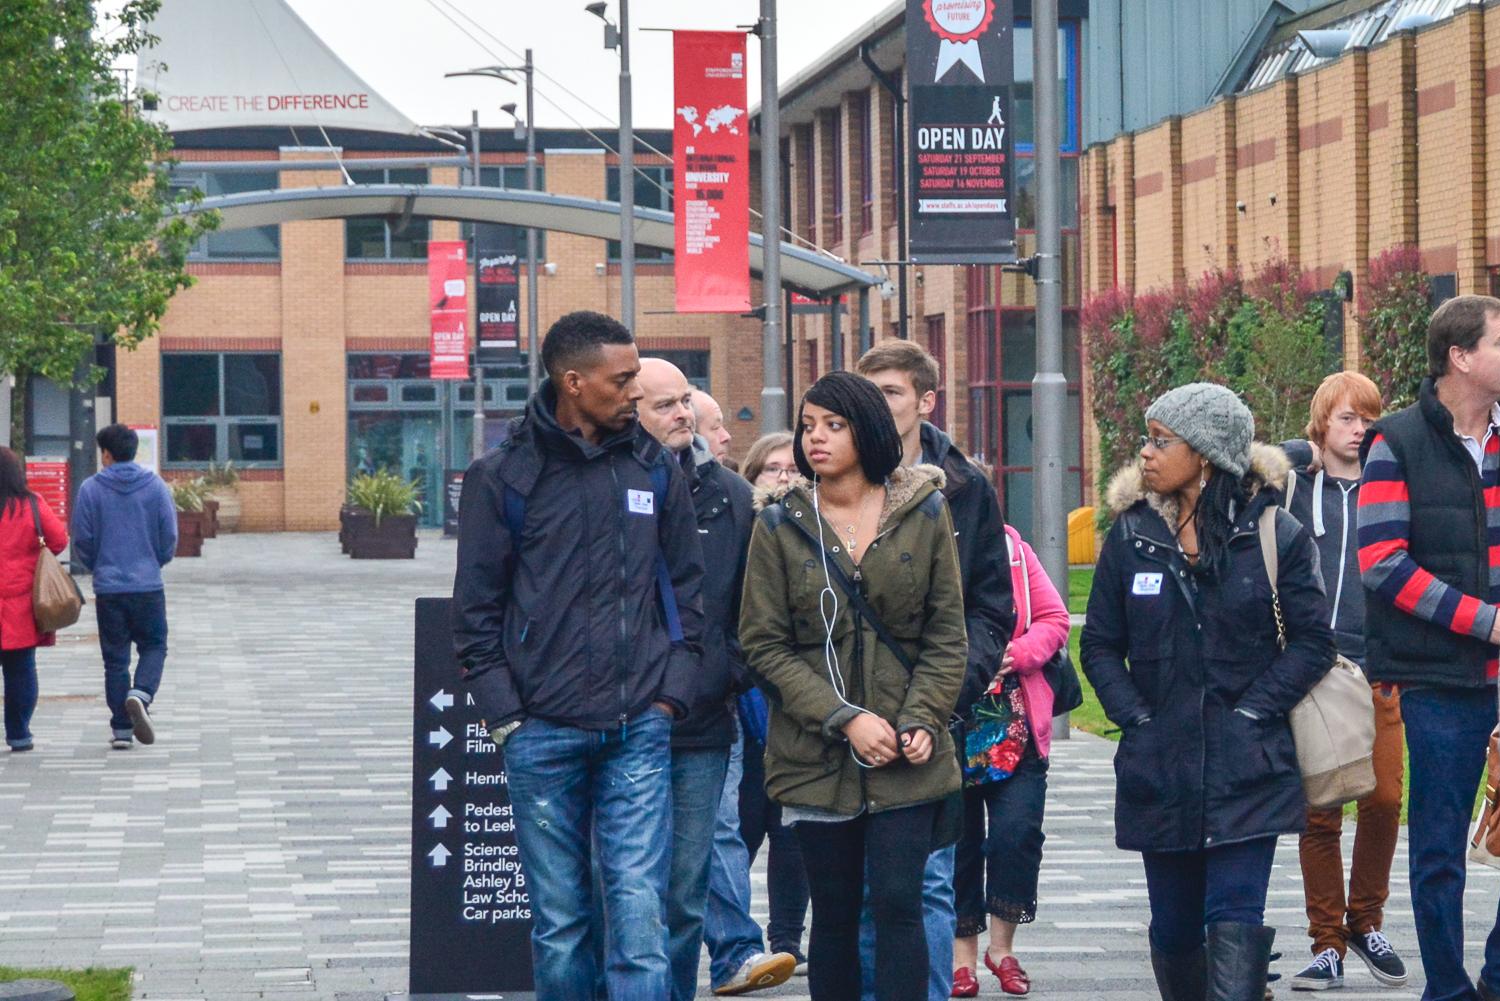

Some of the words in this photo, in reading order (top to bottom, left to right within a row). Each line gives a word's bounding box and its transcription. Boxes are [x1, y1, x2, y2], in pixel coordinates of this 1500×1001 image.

[947, 13, 971, 21] FUTURE
[167, 96, 230, 112] CREATE
[233, 96, 264, 111] THE
[267, 94, 369, 111] DIFFERENCE
[918, 127, 965, 149] OPEN
[971, 127, 1005, 149] DAY
[918, 153, 953, 163] SATURDAY
[954, 153, 962, 163] 21
[964, 153, 1006, 163] SEPTEMBER
[686, 172, 729, 183] UNIVERSITY
[923, 166, 957, 176] SATURDAY
[960, 166, 967, 176] 19
[968, 166, 1001, 176] OCTOBER
[920, 178, 954, 188] SATURDAY
[965, 178, 1004, 188] NOVEMBER
[480, 312, 500, 322] OPEN
[502, 312, 516, 322] DAY
[466, 739, 496, 753] Film
[465, 802, 514, 816] Pedest
[464, 821, 480, 832] to
[464, 842, 518, 856] Science
[464, 857, 521, 875] Brindley
[463, 873, 512, 891] Ashley
[515, 873, 526, 887] B
[464, 890, 493, 904] Law
[463, 906, 489, 920] Car
[493, 905, 532, 924] parks
